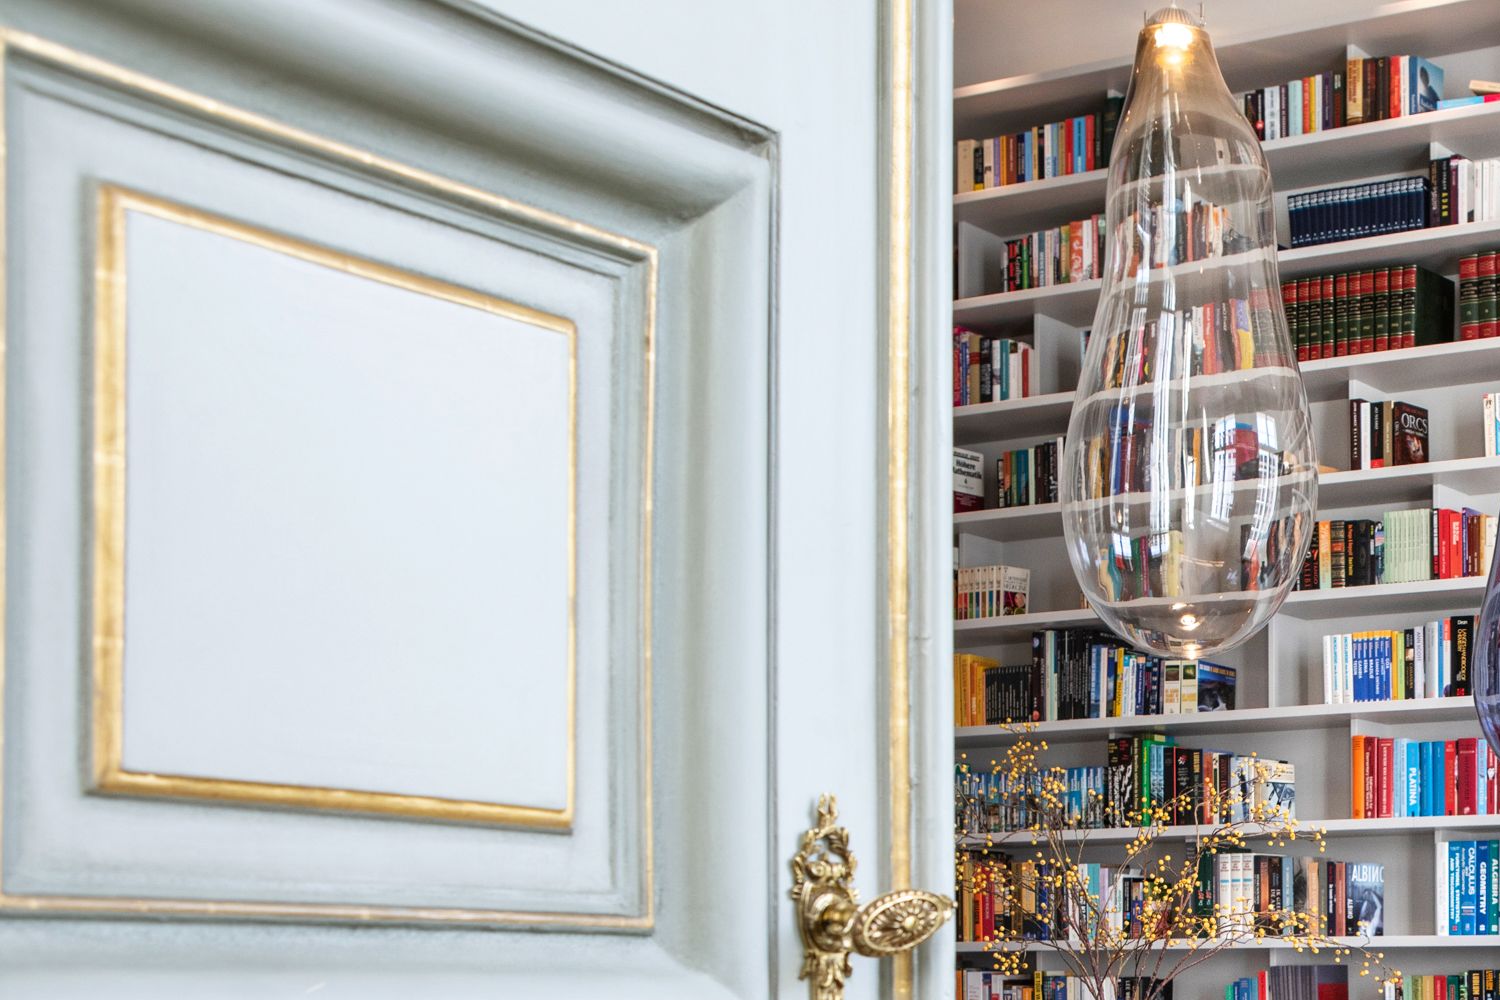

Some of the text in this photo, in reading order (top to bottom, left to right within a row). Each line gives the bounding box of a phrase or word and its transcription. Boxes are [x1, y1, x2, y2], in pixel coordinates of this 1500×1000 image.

[1400, 412, 1428, 433] ORCS
[955, 460, 976, 470] Höhere
[1409, 767, 1418, 806] PLATINA
[1472, 973, 1480, 996] LUDLUM
[1486, 970, 1494, 991] LUDLUM
